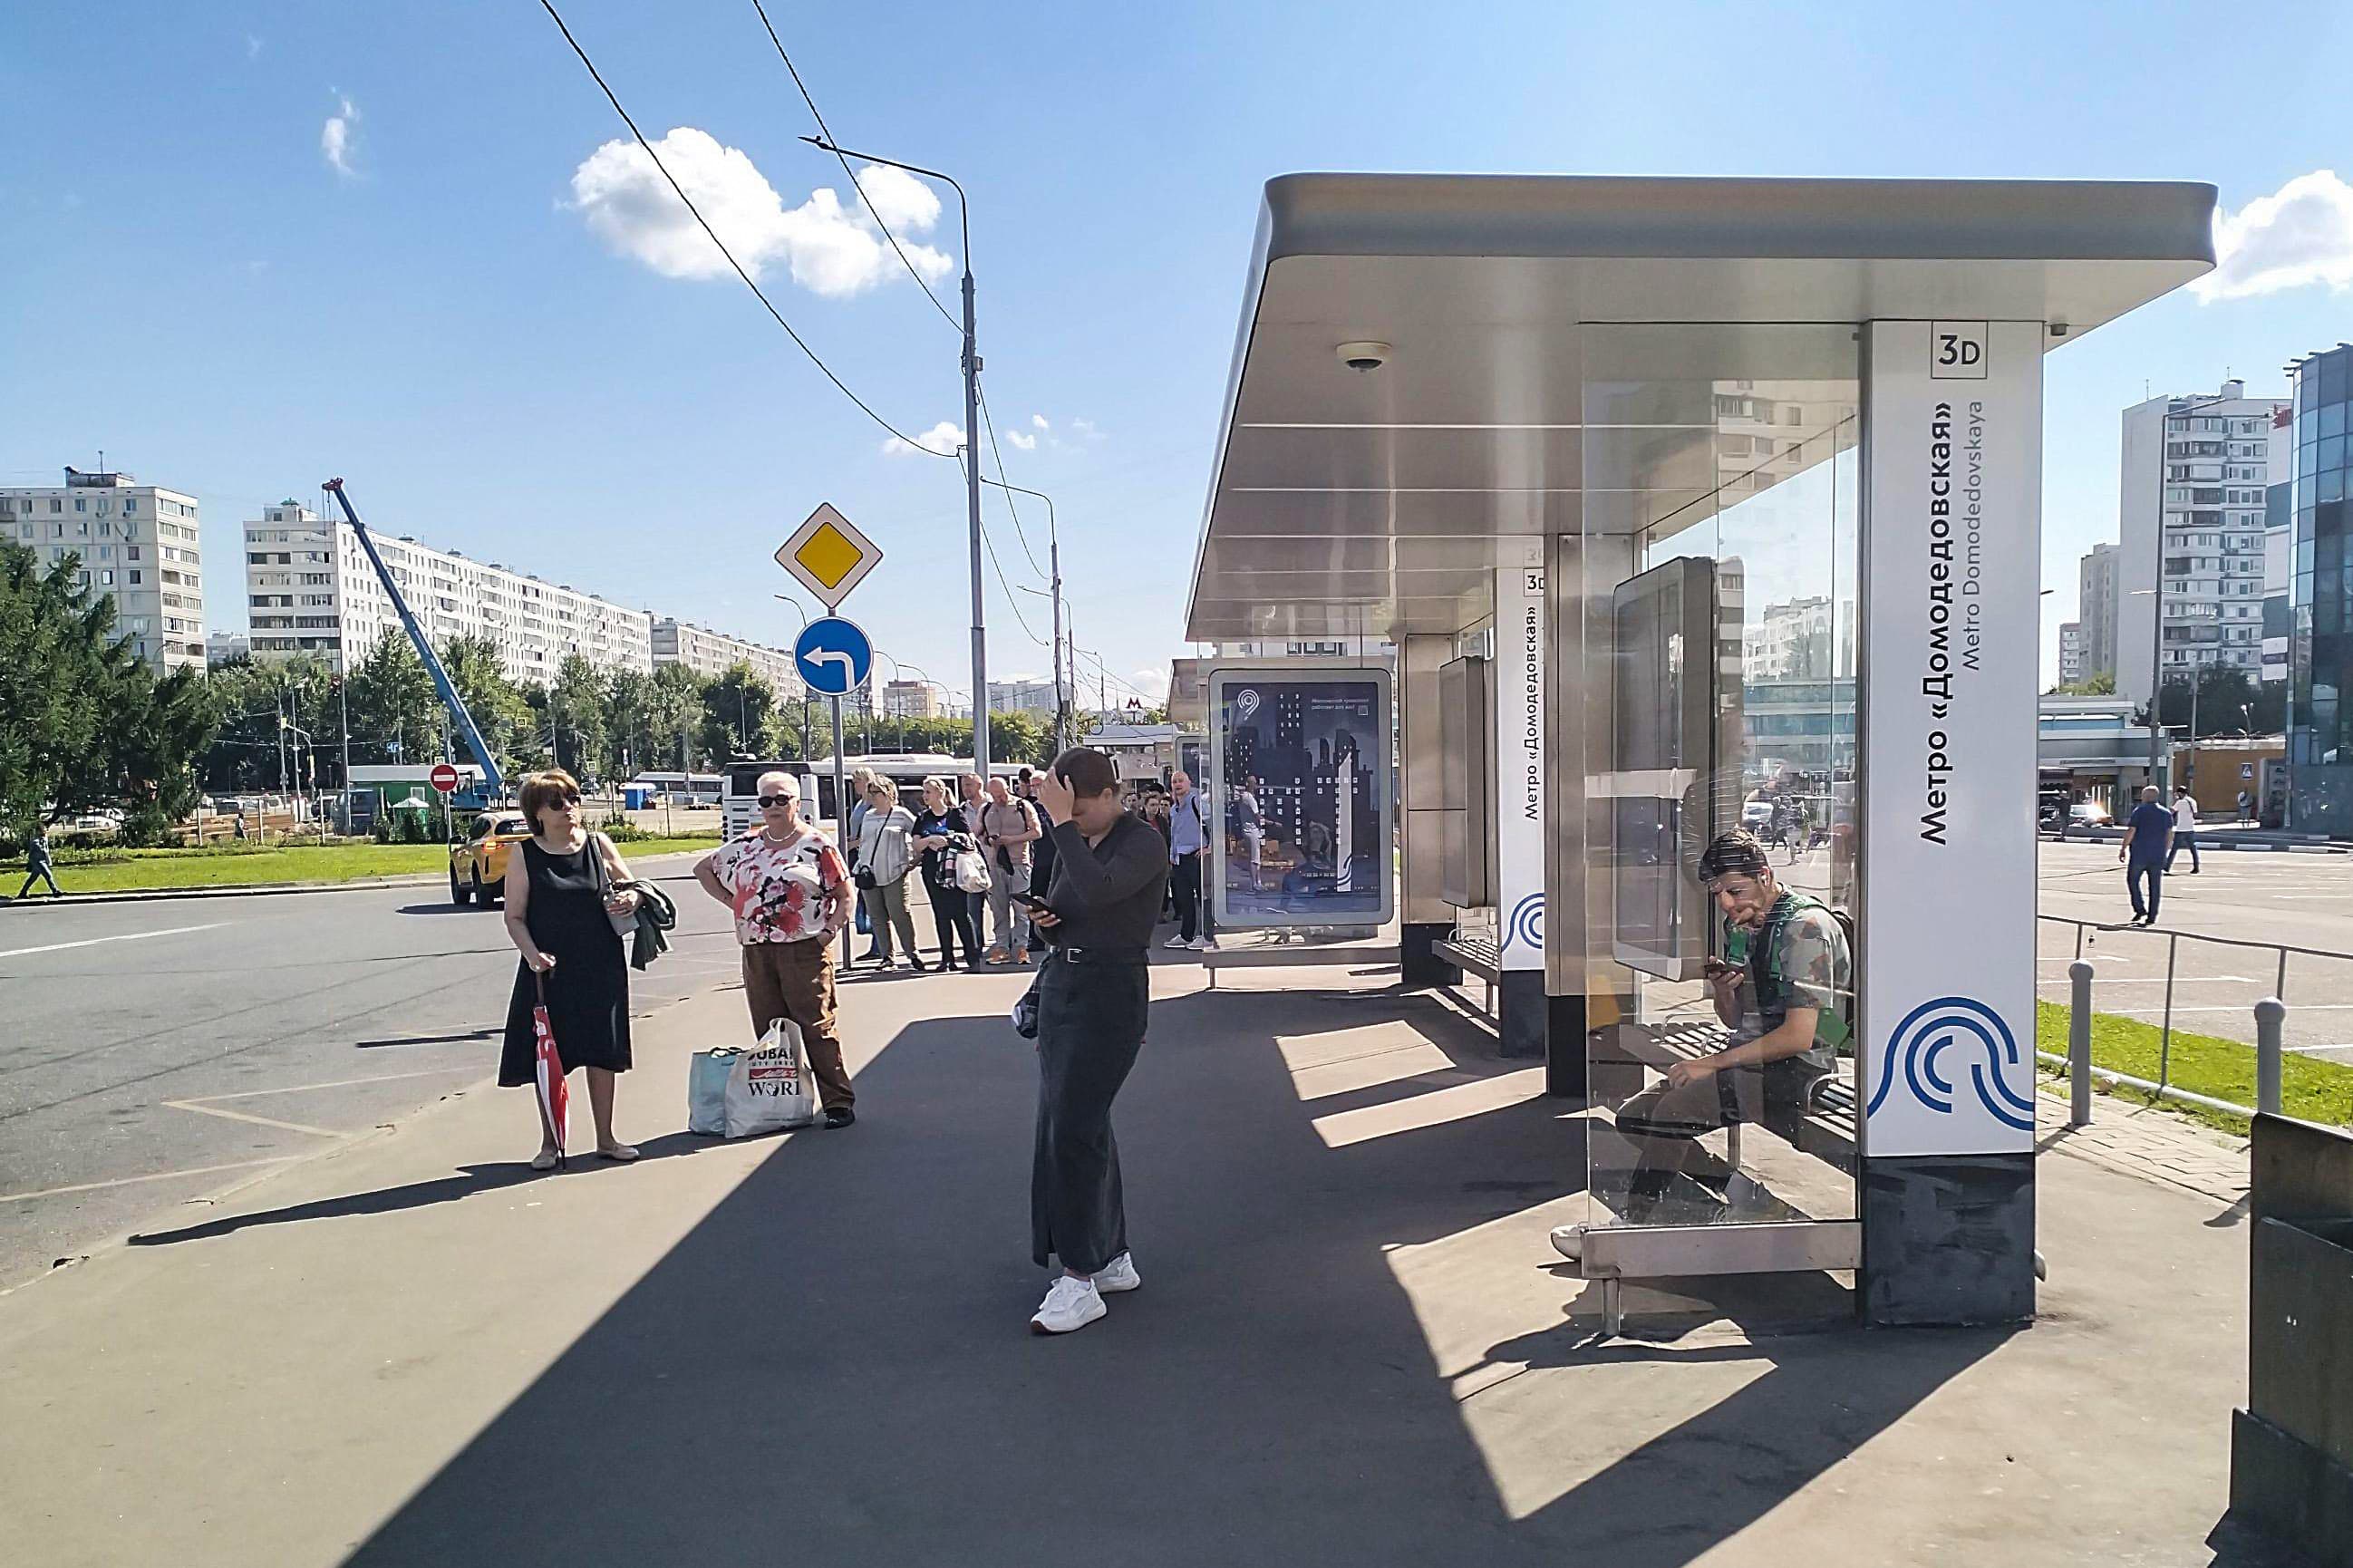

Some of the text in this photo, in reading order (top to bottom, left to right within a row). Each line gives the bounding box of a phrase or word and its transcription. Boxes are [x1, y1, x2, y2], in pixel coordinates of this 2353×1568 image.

[1938, 334, 1980, 365] 3D
[1920, 402, 1954, 846] Метро «Домодедовская»
[1961, 402, 1986, 672] Metro Domodedovskaya
[1524, 606, 1541, 820] Метро «Домодедовская»
